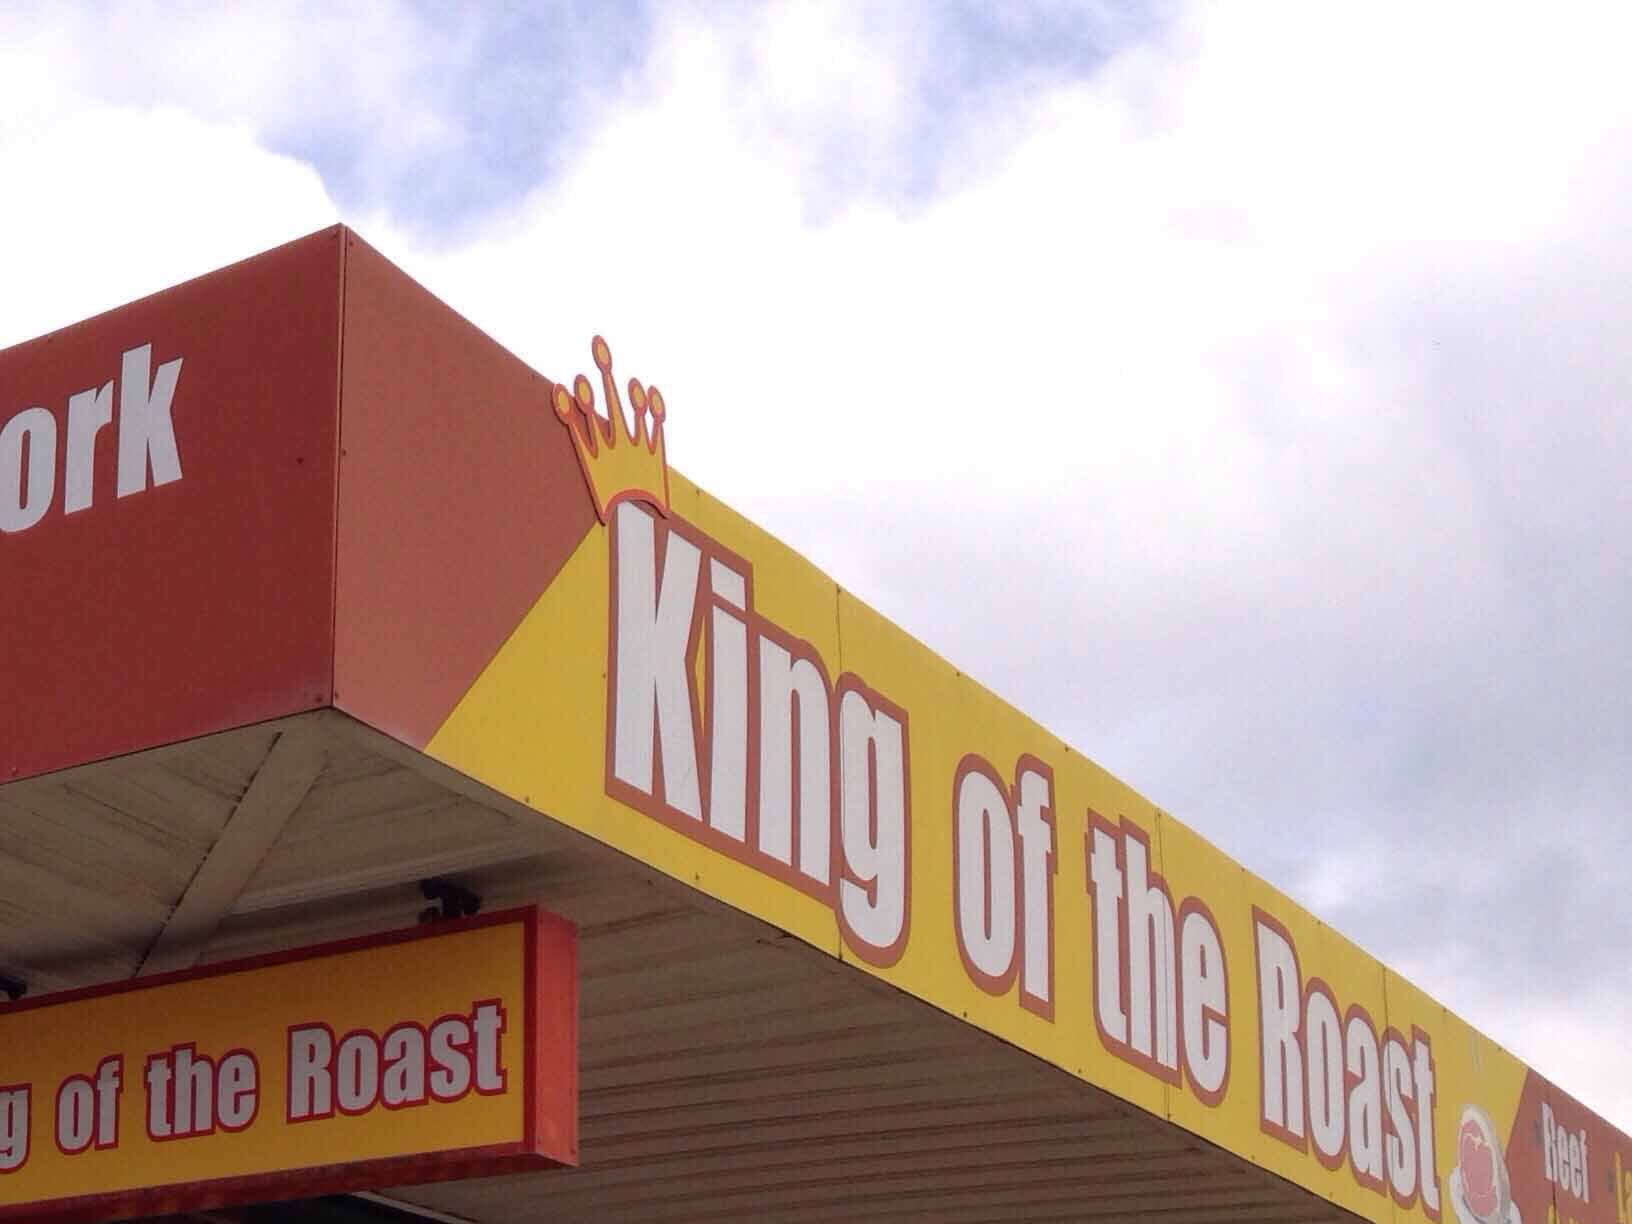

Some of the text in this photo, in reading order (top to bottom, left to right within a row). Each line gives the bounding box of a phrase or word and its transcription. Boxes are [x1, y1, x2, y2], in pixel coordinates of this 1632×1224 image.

[608, 500, 1441, 1220] King of the Roast
[56, 1056, 123, 1153] of
[147, 1045, 258, 1140] the
[289, 1001, 505, 1122] Roast
[1542, 1103, 1590, 1204] Beef
